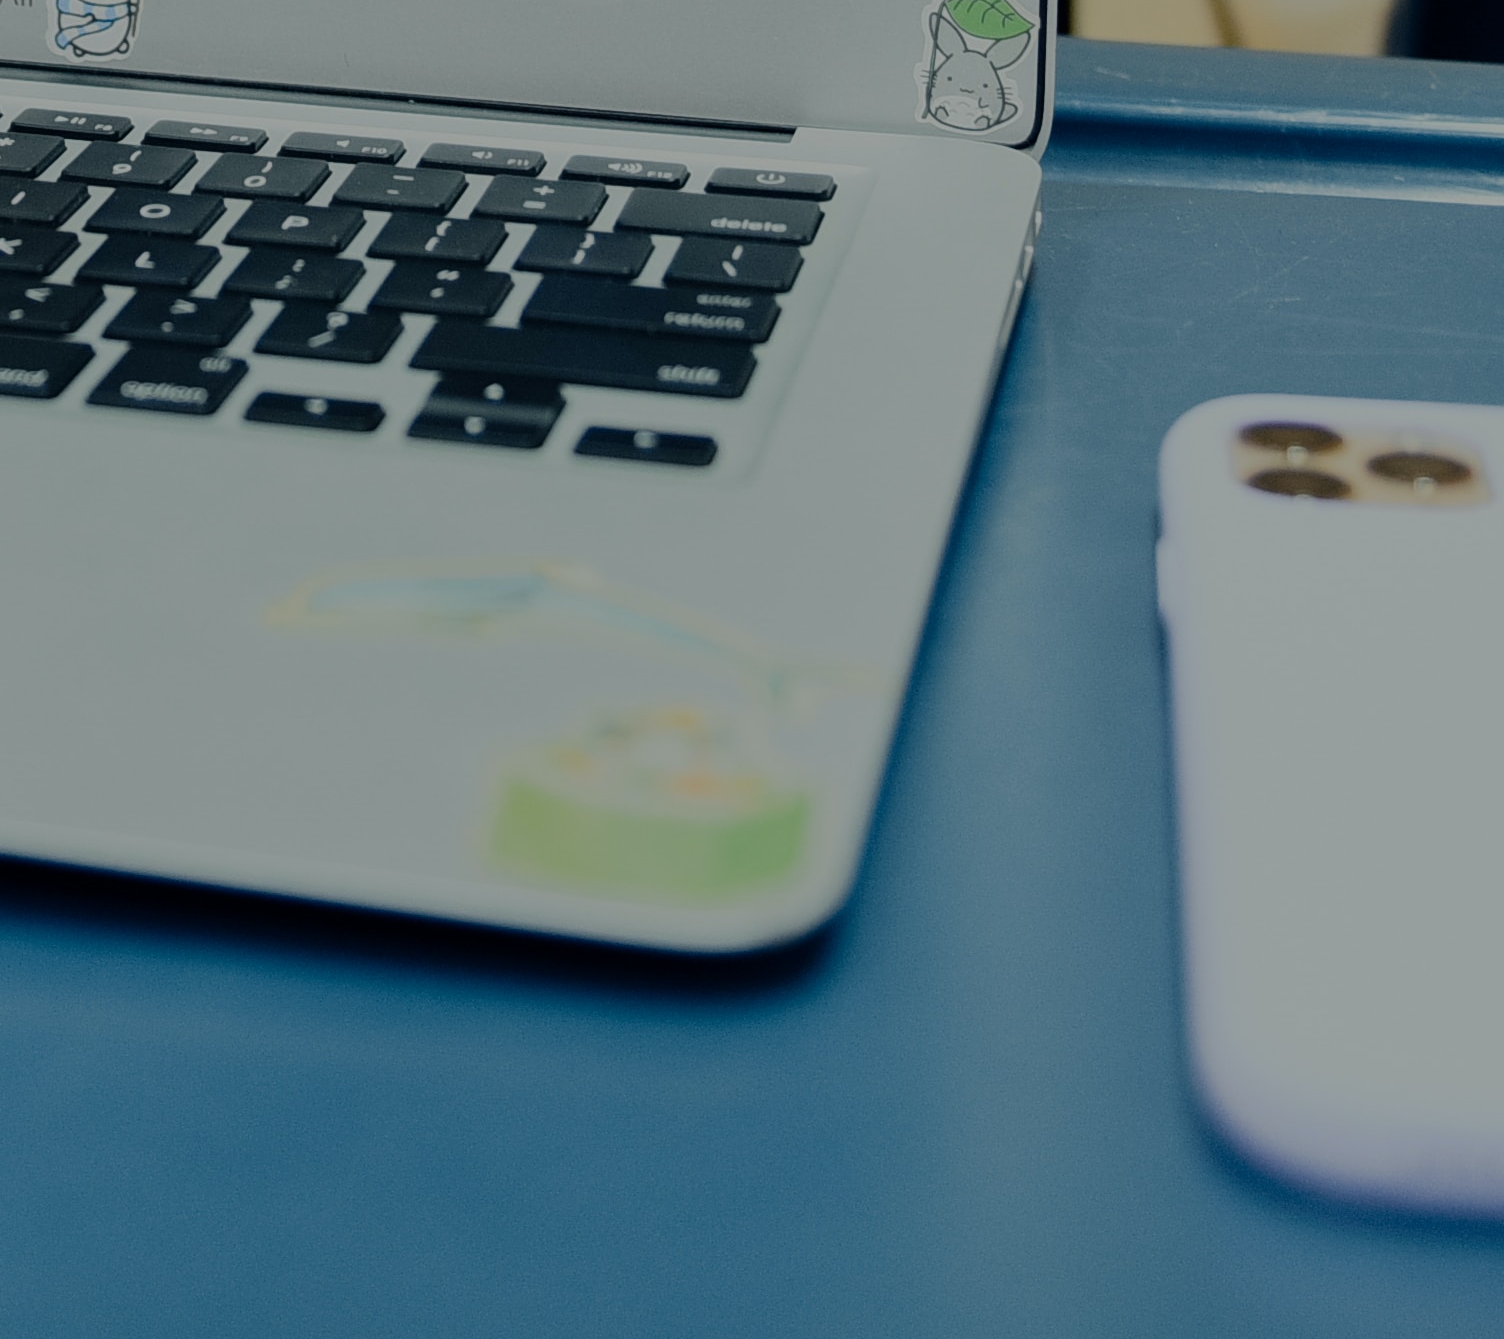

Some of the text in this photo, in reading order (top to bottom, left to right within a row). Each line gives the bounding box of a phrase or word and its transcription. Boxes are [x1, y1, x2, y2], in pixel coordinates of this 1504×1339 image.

[112, 163, 132, 175] 9
[281, 215, 310, 231] P
[710, 217, 788, 233] delete
[135, 252, 153, 268] L
